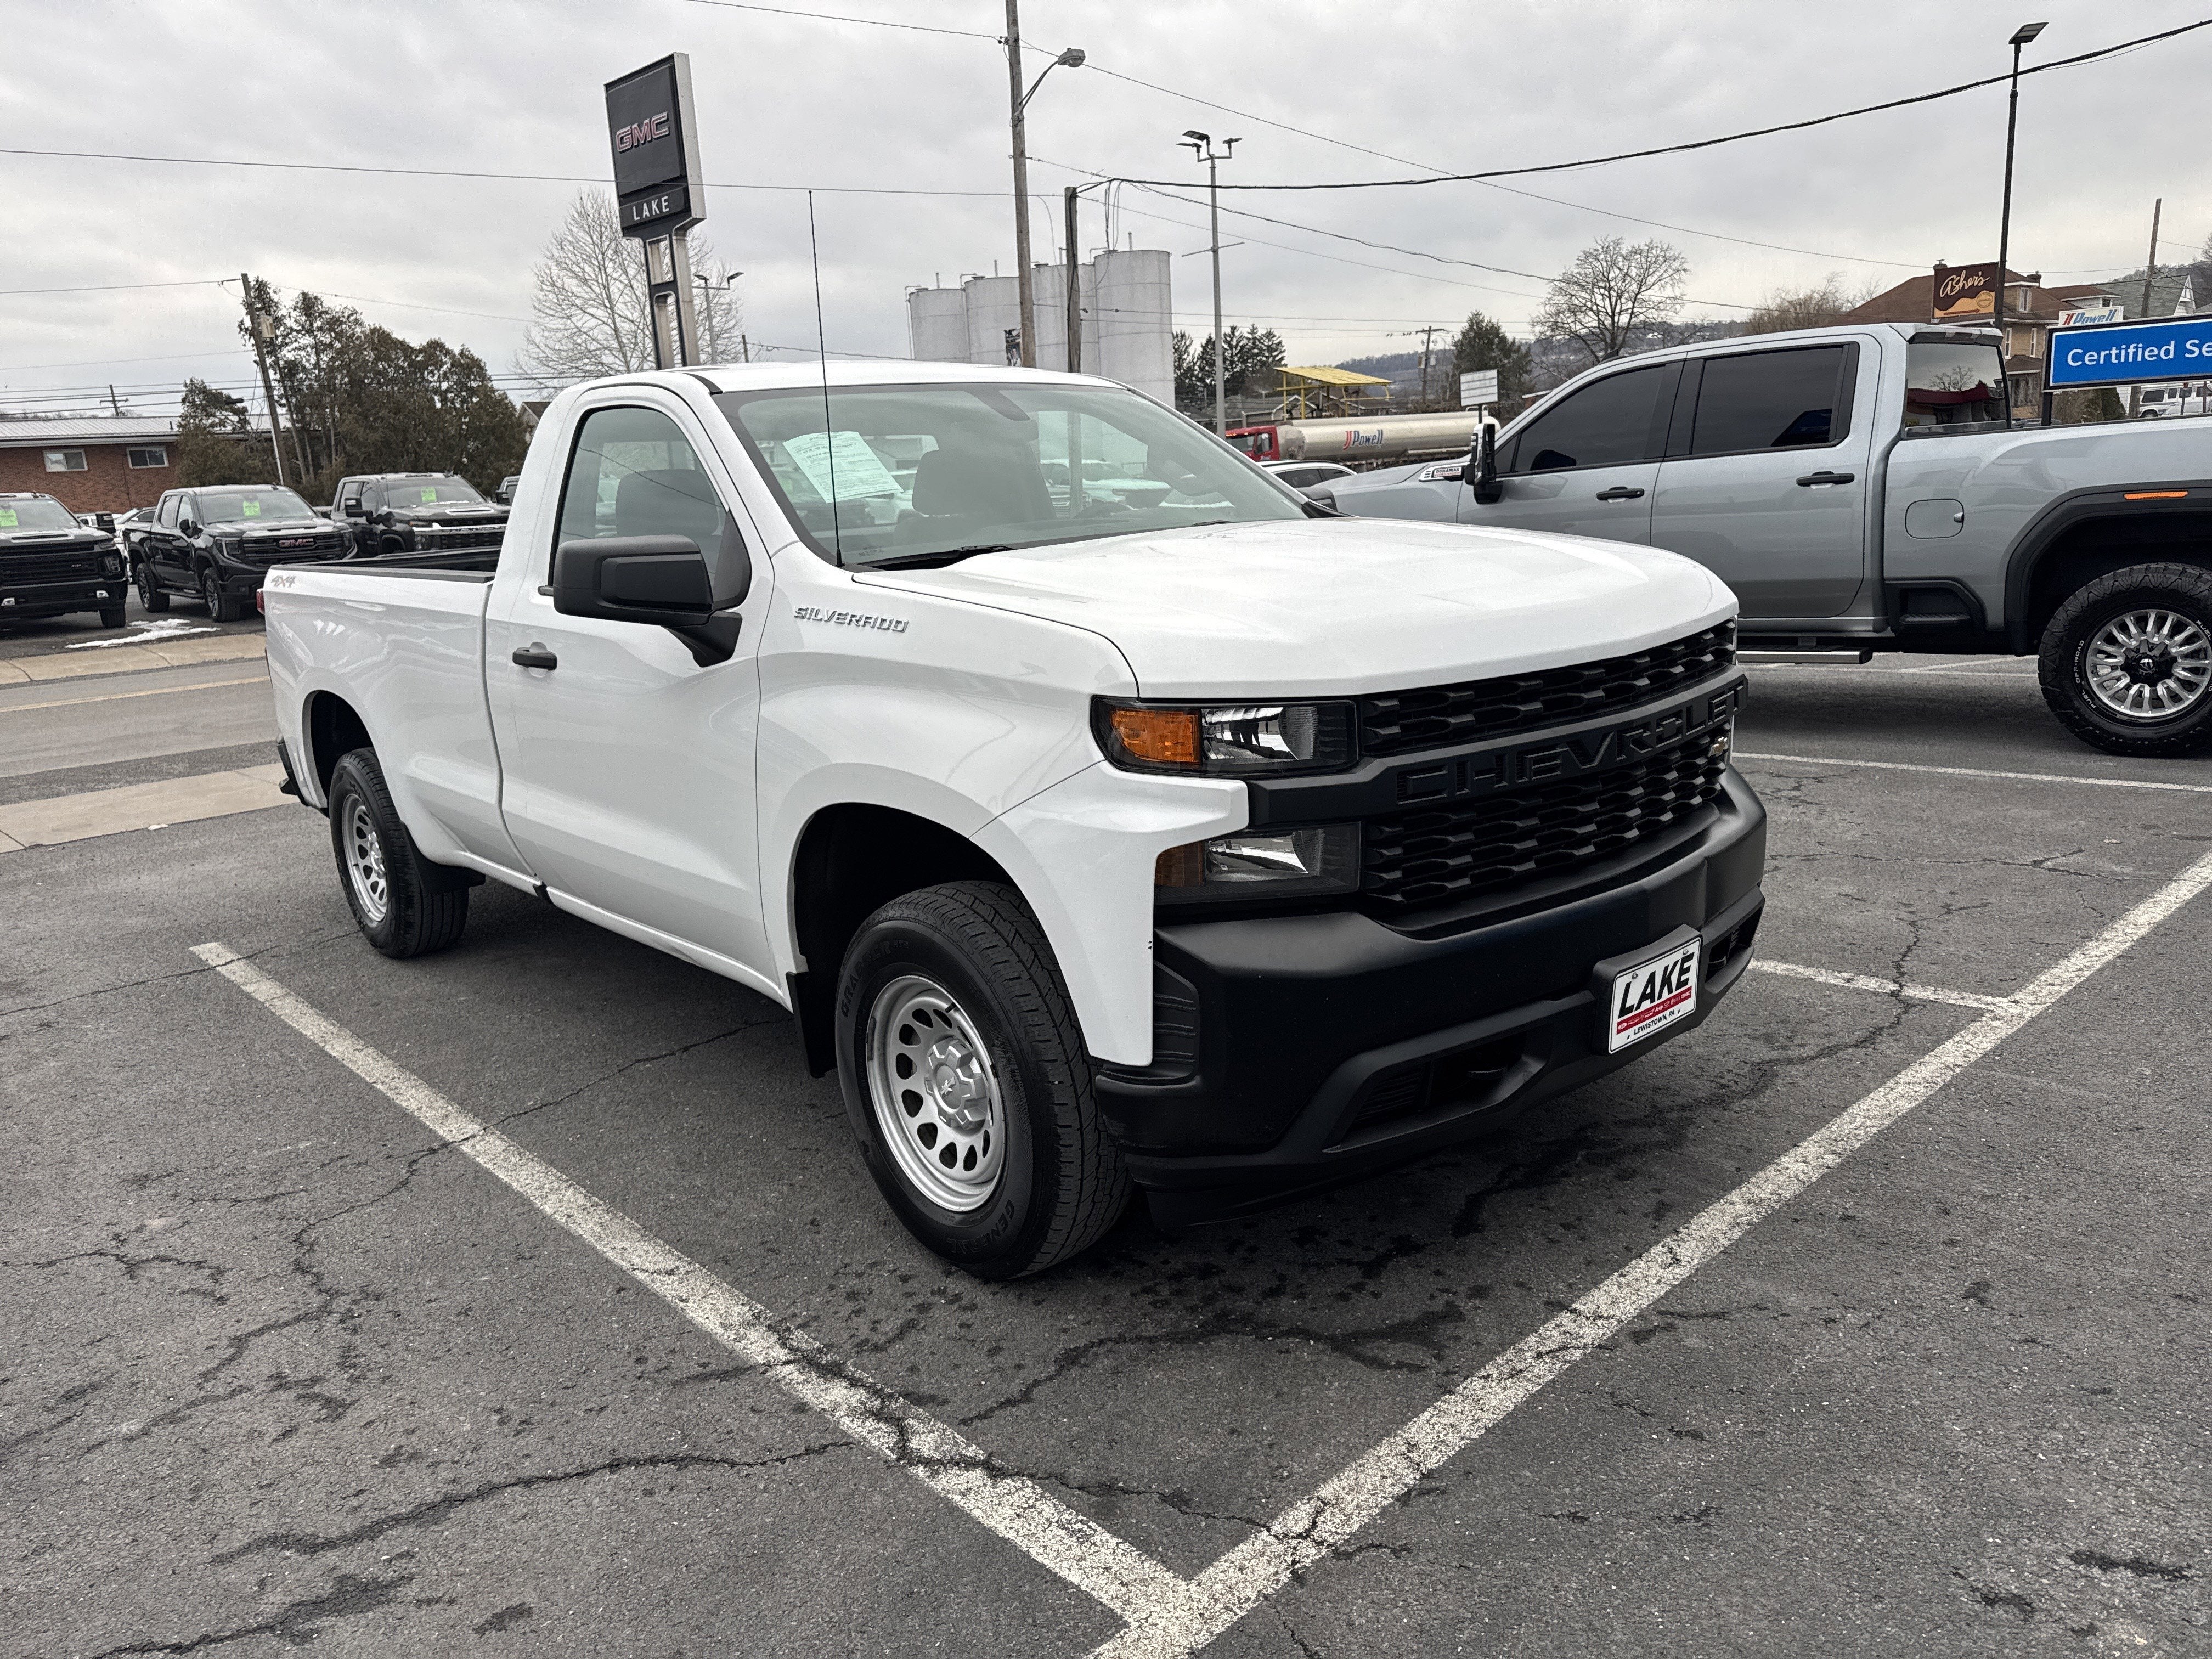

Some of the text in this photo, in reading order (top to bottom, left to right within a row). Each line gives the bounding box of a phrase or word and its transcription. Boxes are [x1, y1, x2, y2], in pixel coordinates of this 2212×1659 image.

[616, 111, 669, 153] GMC
[633, 195, 670, 221] LAKE
[1939, 270, 1990, 297] Asher's
[2067, 340, 2176, 366] Certified
[279, 538, 314, 548] GMC
[793, 606, 910, 633] SILVERADO
[2074, 640, 2085, 684] OFF-ROAD
[1396, 685, 1745, 805] CHEVROLET
[1618, 952, 1695, 1019] LAKE
[1634, 1013, 1668, 1035] LEWISTOWN,
[1668, 1009, 1675, 1018] PA
[946, 1199, 1015, 1254] GENERAL
